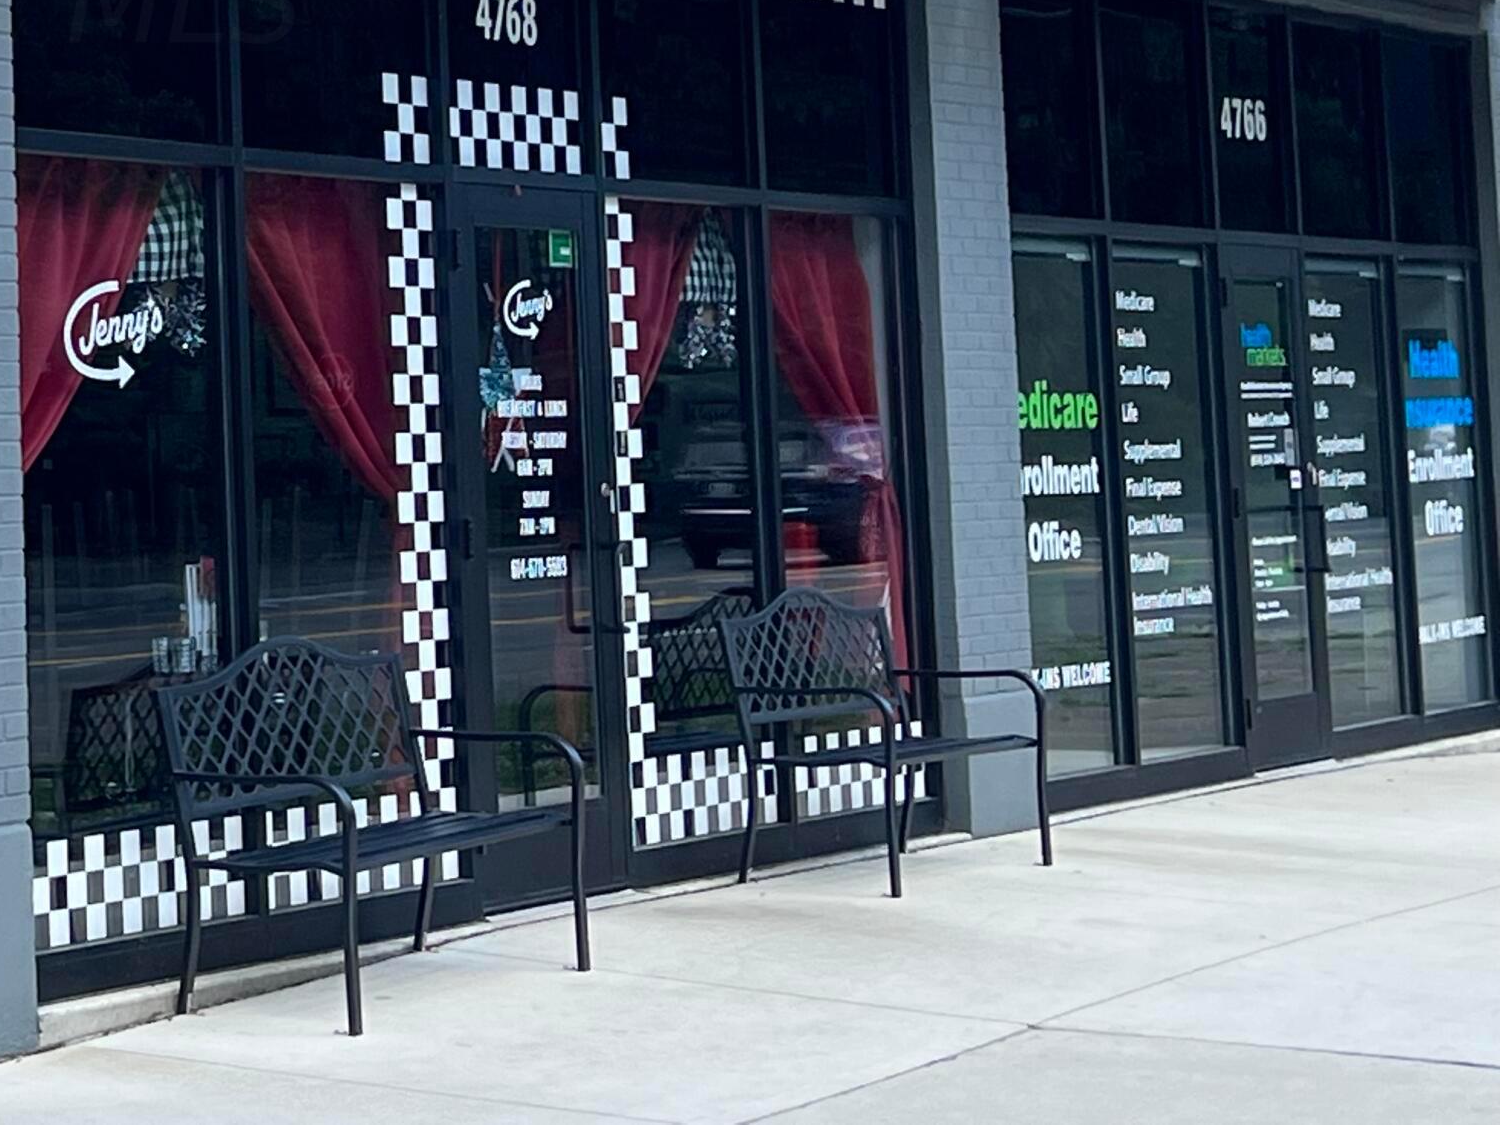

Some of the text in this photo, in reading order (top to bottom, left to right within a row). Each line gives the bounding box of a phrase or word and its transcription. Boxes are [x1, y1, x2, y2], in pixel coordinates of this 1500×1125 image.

[1221, 97, 1267, 142] 4766
[78, 291, 163, 355] Jenny's
[510, 288, 553, 322] Jenny's
[1408, 339, 1461, 378] Health
[1017, 380, 1099, 429] edicare
[1021, 455, 1100, 496] rollment
[1408, 447, 1475, 483] Enrollment
[1425, 500, 1463, 536] Office
[1028, 521, 1081, 562] Office
[1061, 660, 1112, 688] WELCOME
